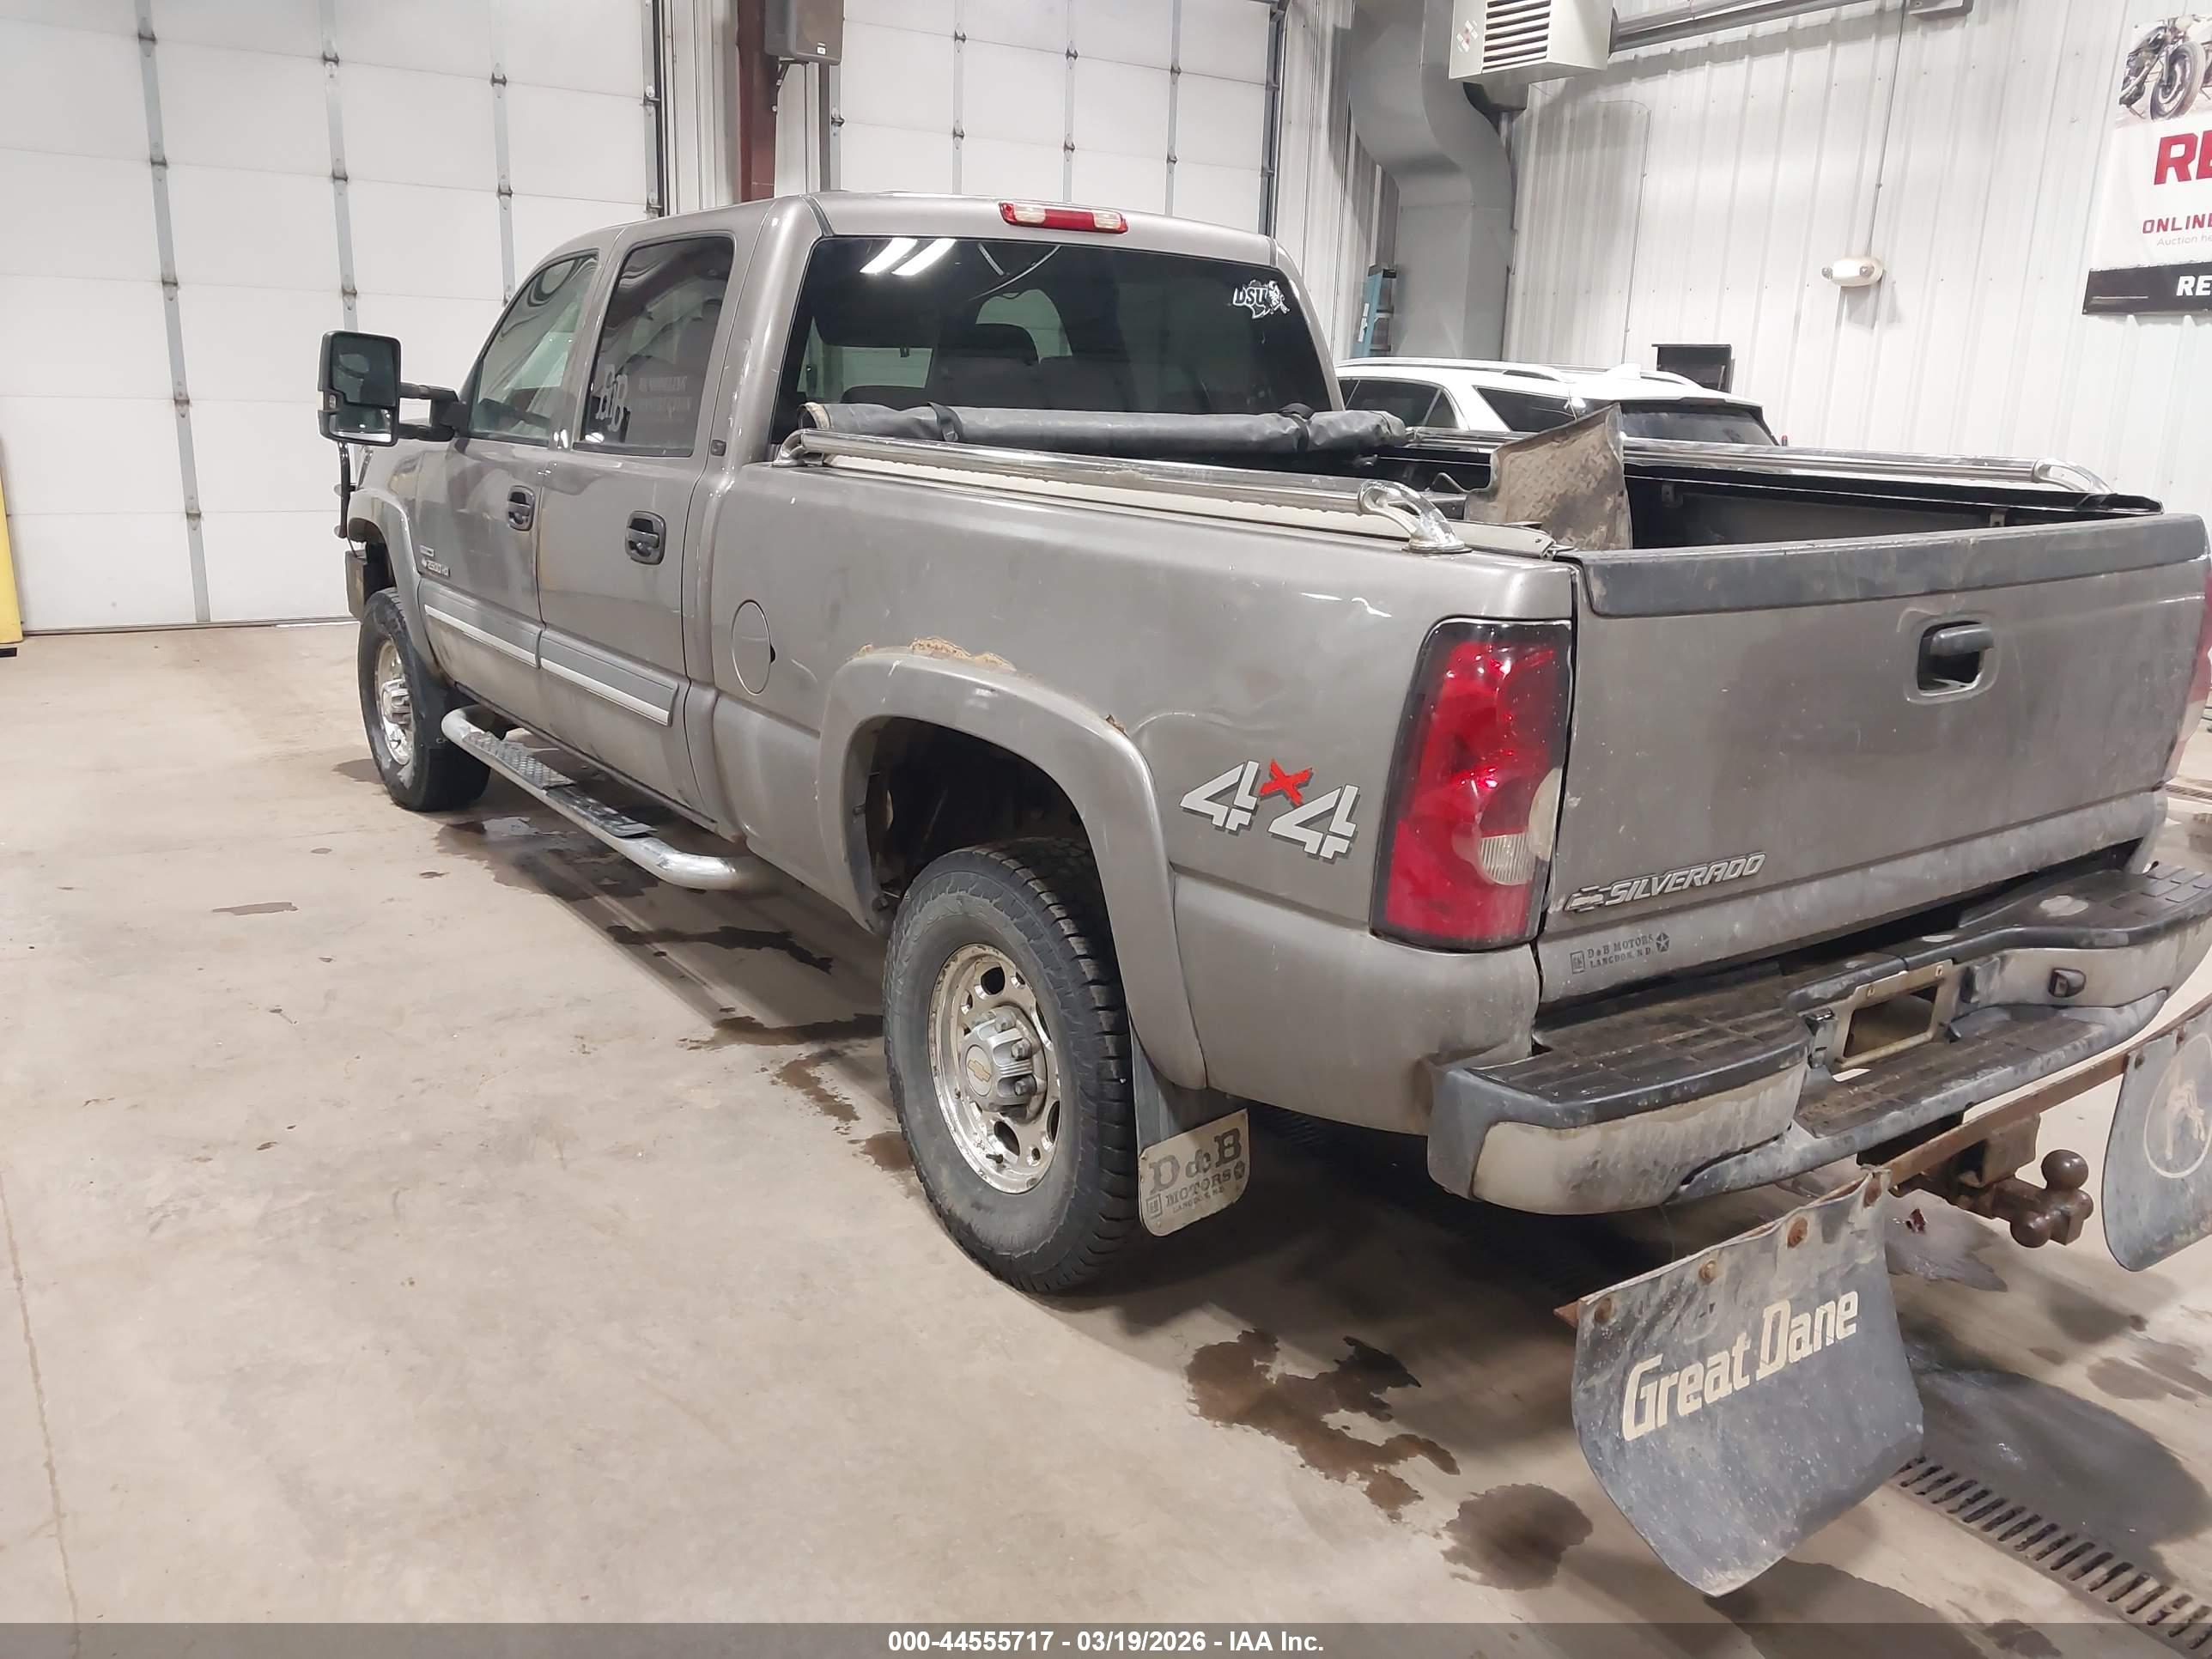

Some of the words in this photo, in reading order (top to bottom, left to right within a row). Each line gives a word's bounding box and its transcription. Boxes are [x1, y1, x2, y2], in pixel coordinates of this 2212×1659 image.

[2156, 236, 2198, 246] Auction
[1604, 852, 1766, 906] SILVERADO
[1613, 933, 1654, 951] MOTORS
[1165, 1169, 1231, 1207] MOTORS
[1621, 1330, 1752, 1443] Great
[1755, 1291, 1859, 1381] Dane
